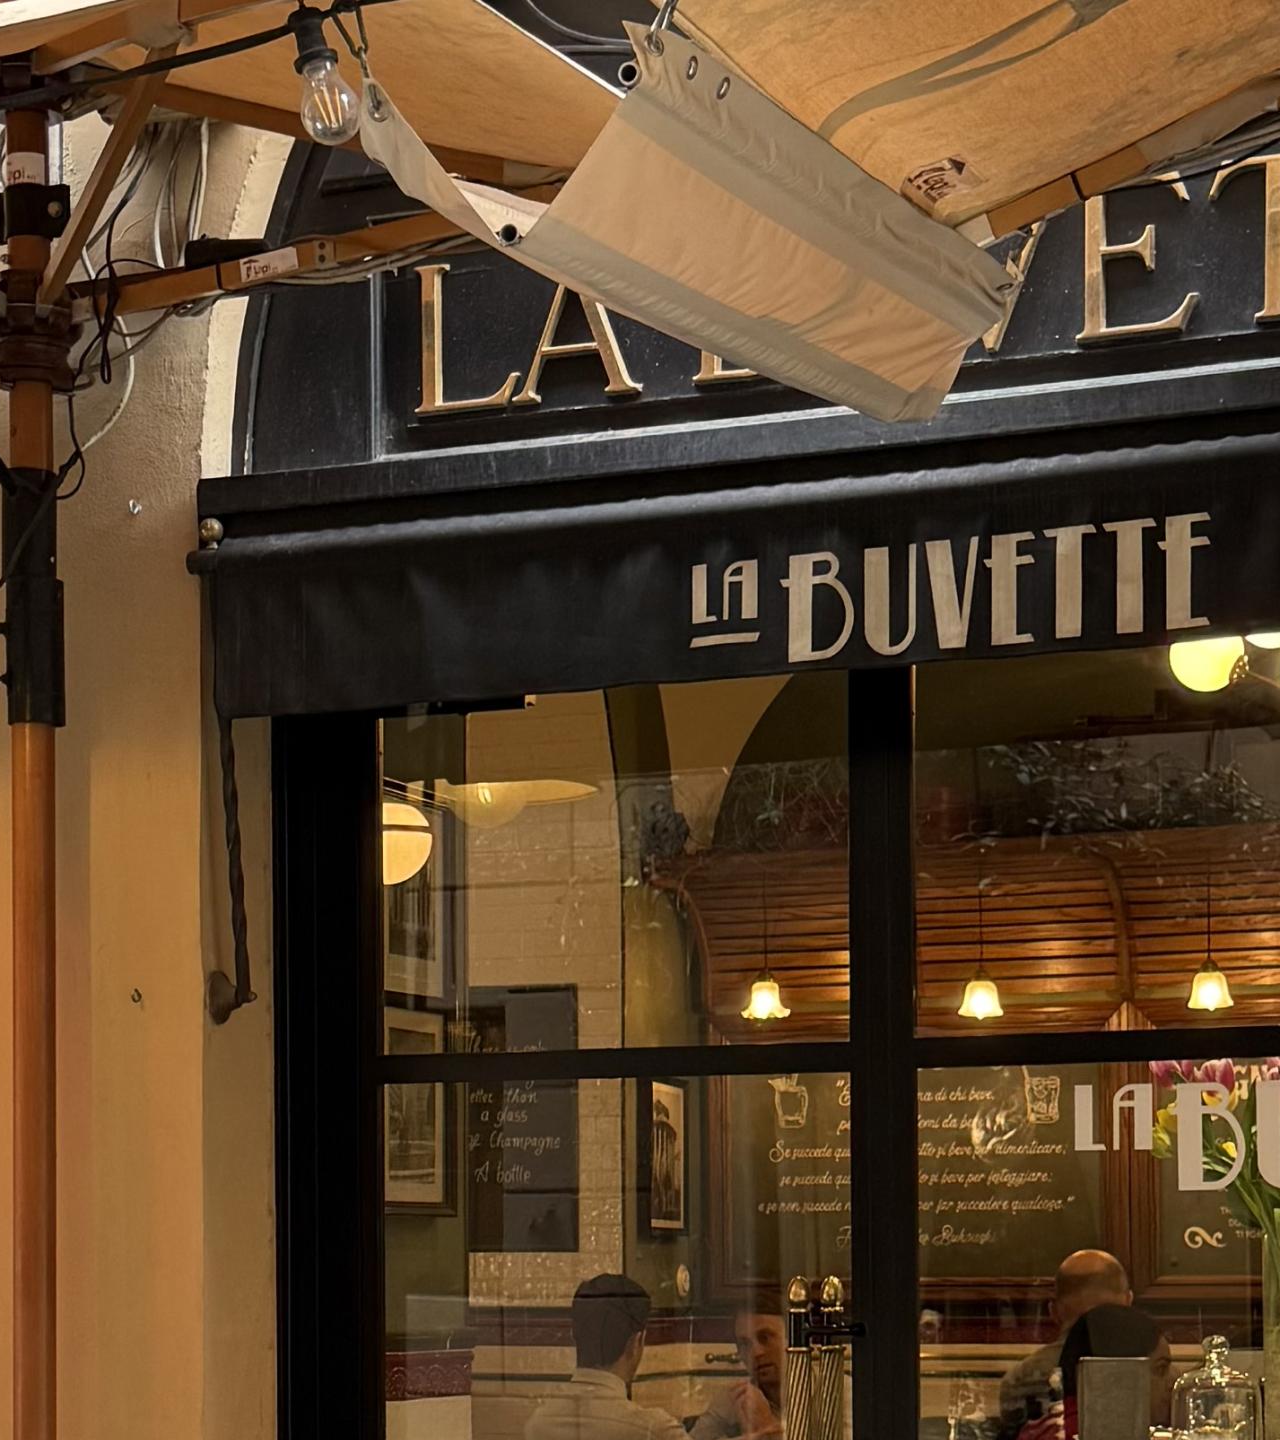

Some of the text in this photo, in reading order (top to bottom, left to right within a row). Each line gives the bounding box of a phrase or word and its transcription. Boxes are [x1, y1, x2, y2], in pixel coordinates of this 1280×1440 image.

[414, 263, 643, 414] LA
[690, 511, 1212, 664] LA BUVETTE
[494, 1106, 528, 1128] glass
[1073, 1083, 1153, 1151] LA
[489, 1130, 561, 1156] Champagne
[769, 1140, 792, 1163] Se
[497, 1161, 531, 1183] bottle
